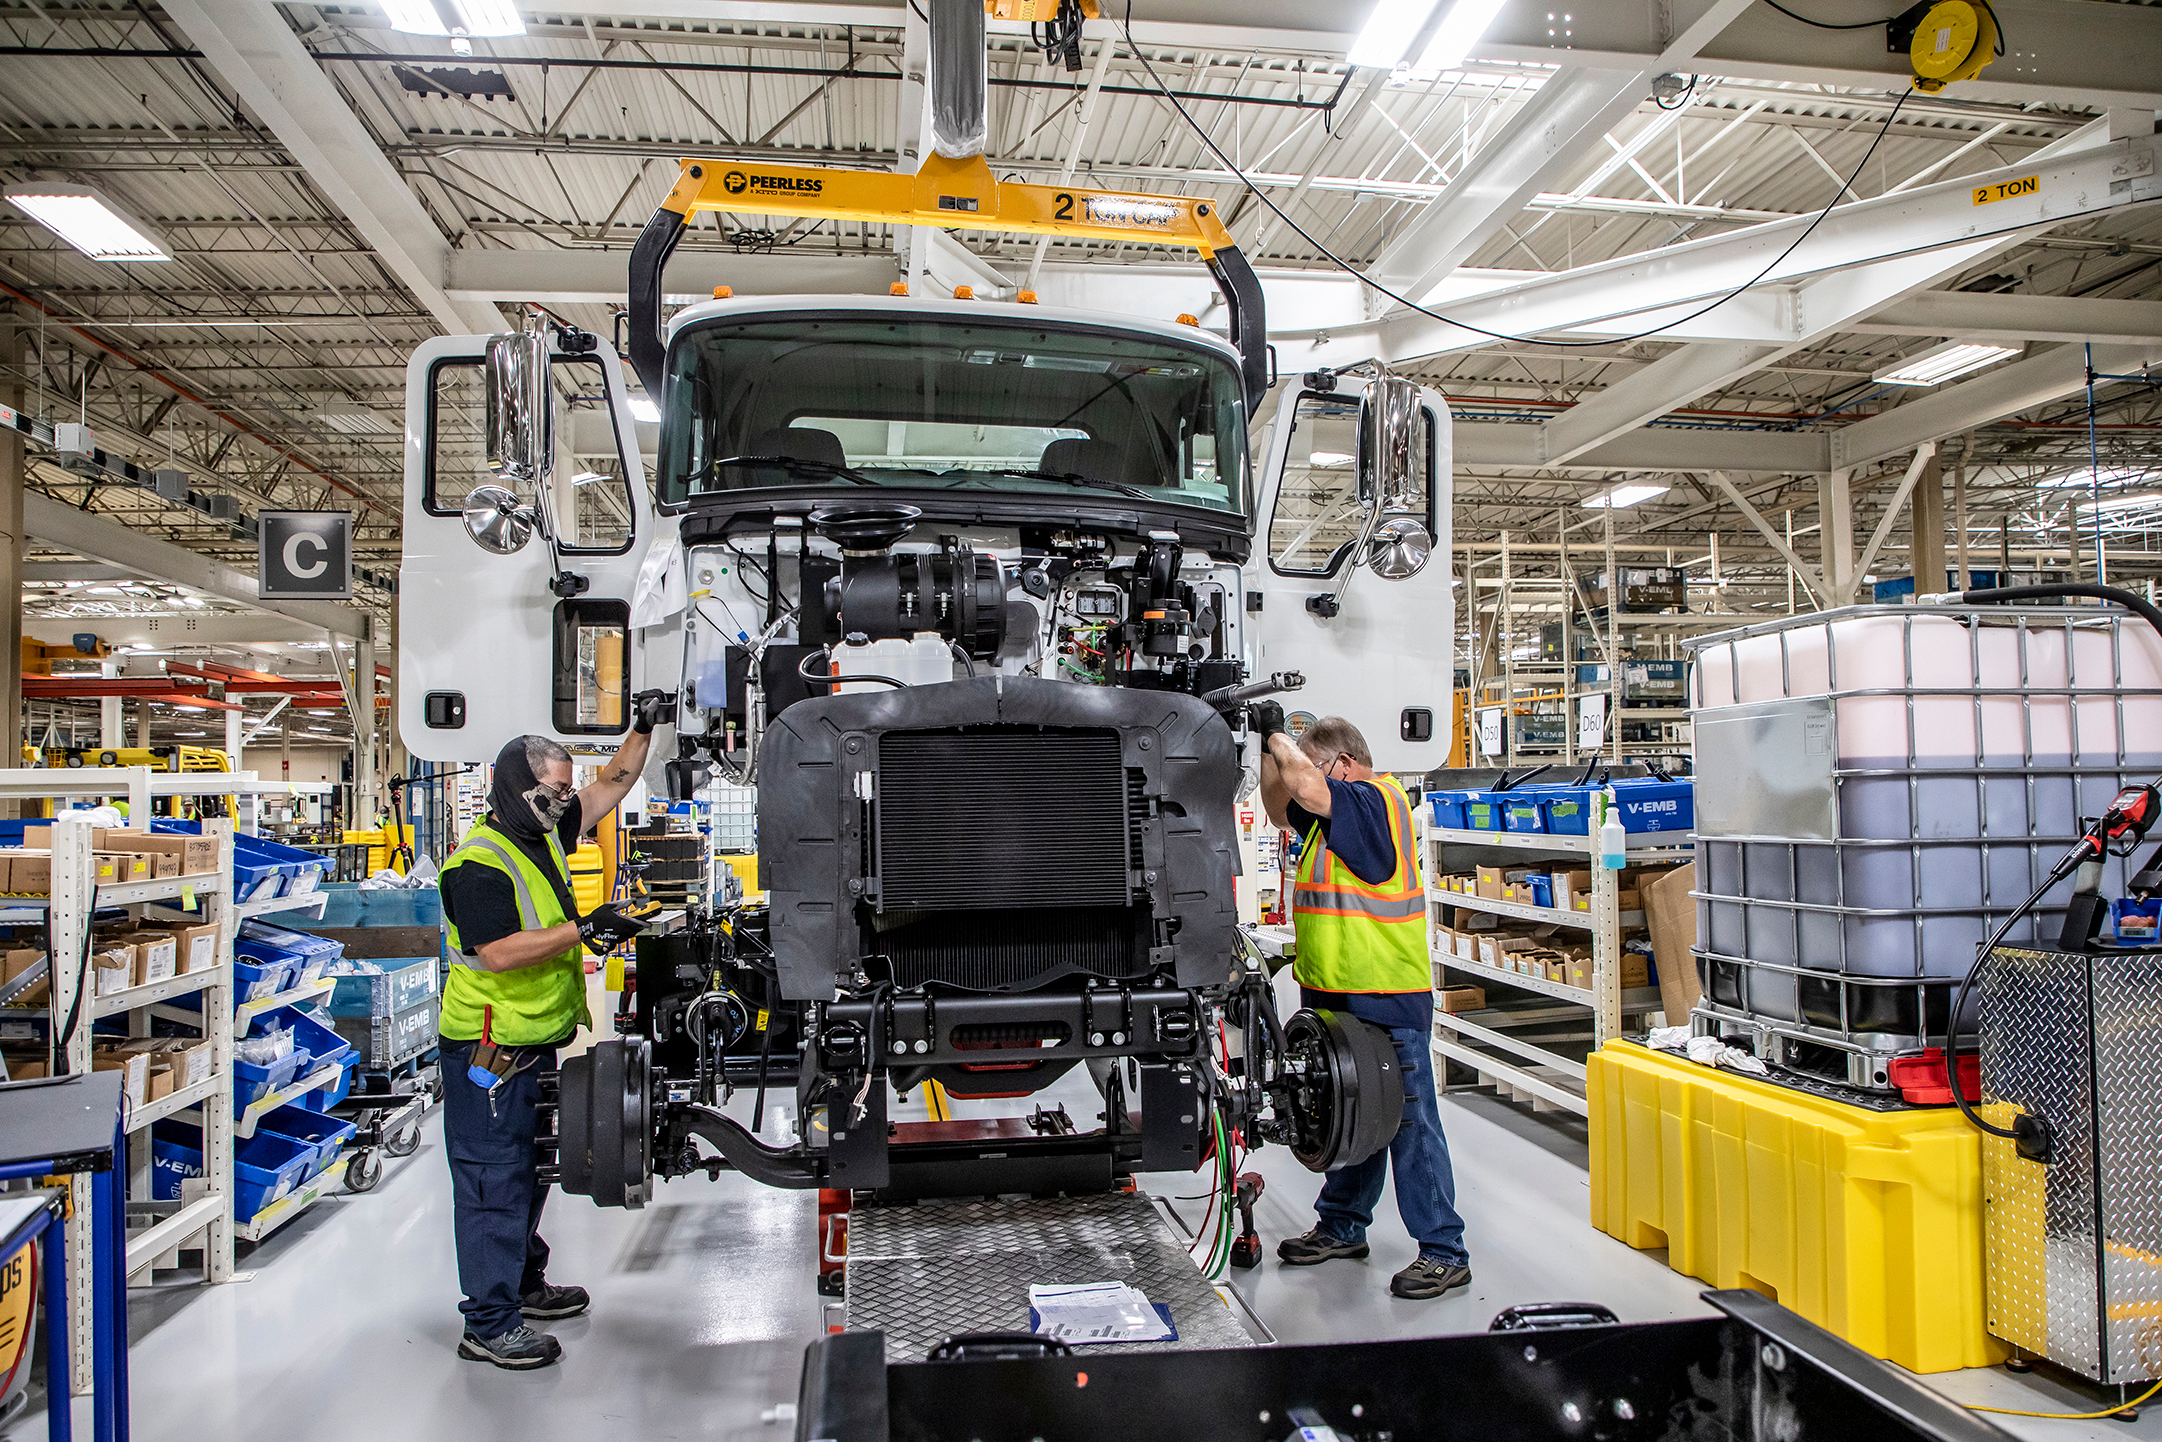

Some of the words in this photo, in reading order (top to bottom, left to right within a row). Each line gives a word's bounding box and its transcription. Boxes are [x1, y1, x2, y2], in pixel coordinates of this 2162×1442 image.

[750, 175, 822, 192] PEERLESS
[1977, 189, 1988, 202] 2
[1996, 178, 2035, 198] TON
[1055, 193, 1074, 221] 2
[283, 532, 328, 579] C
[1532, 715, 1565, 723] V-EMB
[1583, 714, 1600, 732] D60
[1484, 725, 1498, 741] D50
[1532, 731, 1565, 739] V-EMB
[564, 744, 597, 753] ACK
[1627, 800, 1678, 814] V-EMB
[595, 932, 619, 940] HyFlex
[400, 967, 430, 991] V-EMB
[399, 1008, 430, 1036] V-EMB
[154, 1155, 203, 1178] V-EM
